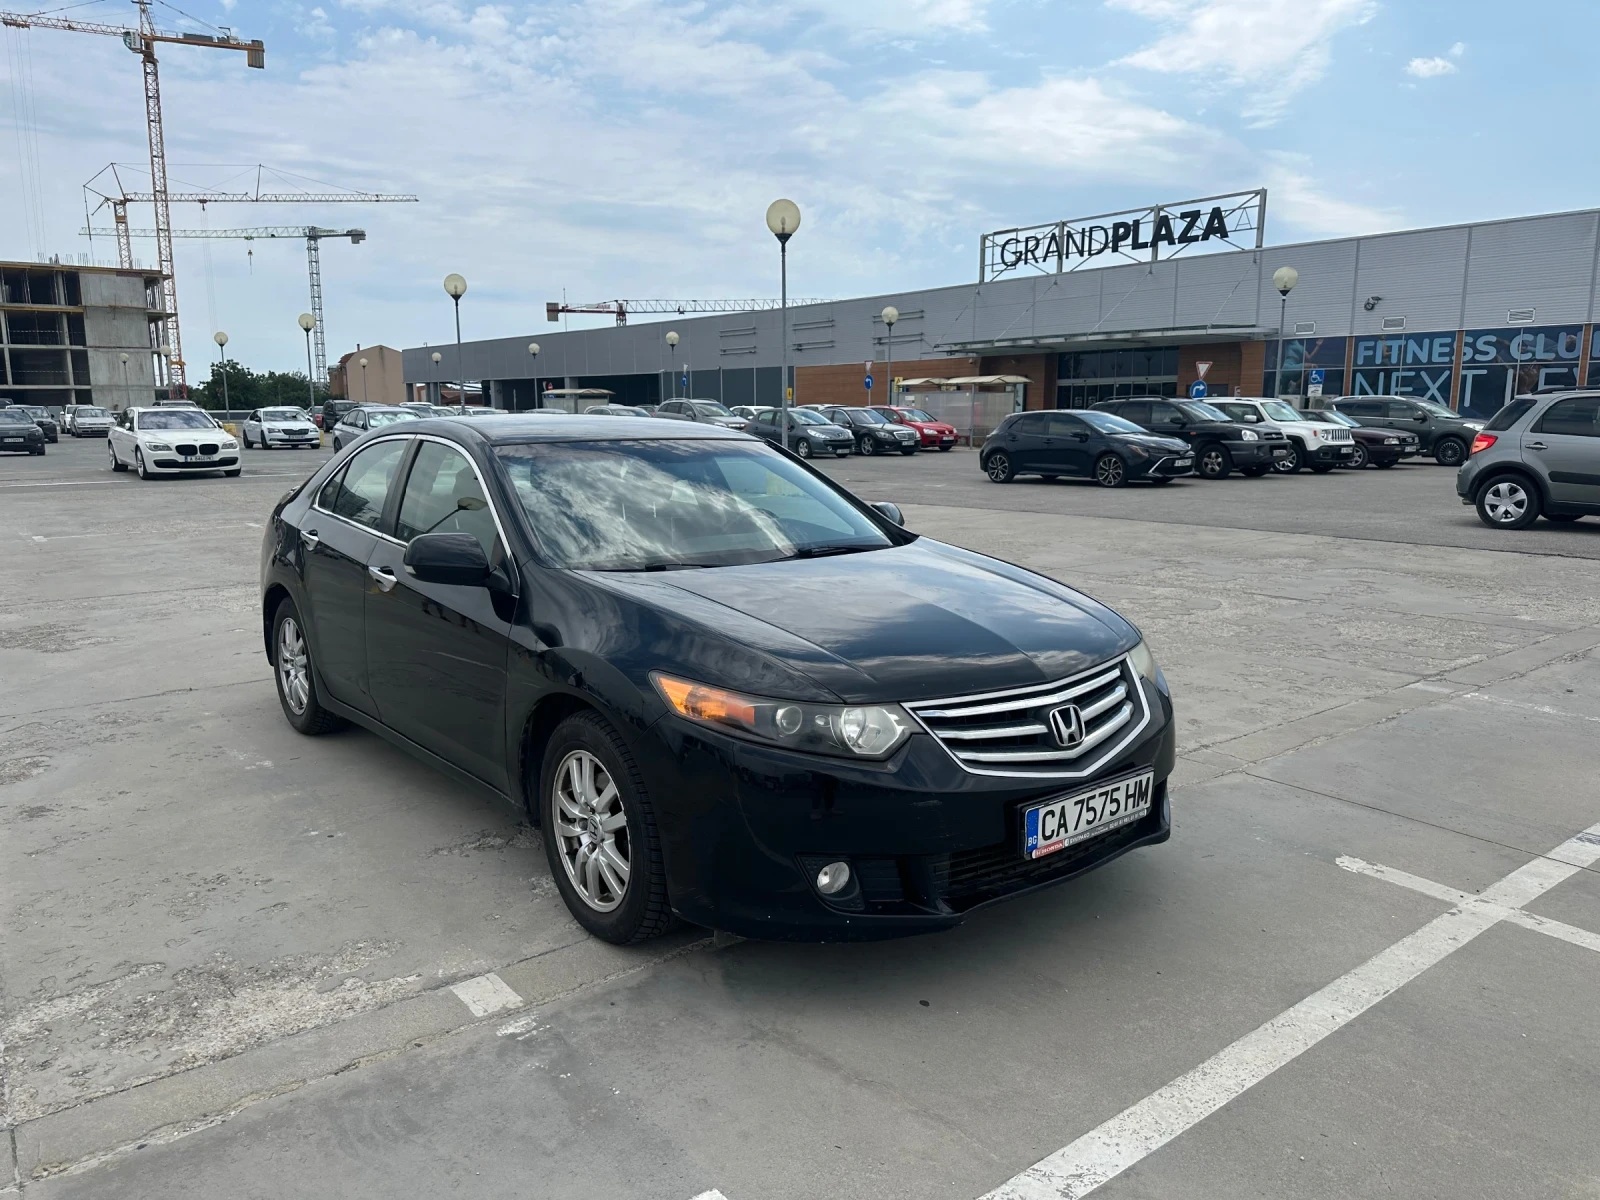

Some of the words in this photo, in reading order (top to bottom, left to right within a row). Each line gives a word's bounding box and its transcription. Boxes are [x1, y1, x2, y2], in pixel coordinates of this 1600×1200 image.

[1357, 334, 1497, 365] FITNESS
[1354, 369, 1488, 408] NEXT
[1041, 805, 1069, 841] CA
[1073, 786, 1121, 831] 7575
[1124, 776, 1151, 812] HM
[1028, 835, 1037, 847] BG
[1041, 843, 1063, 854] HONDA
